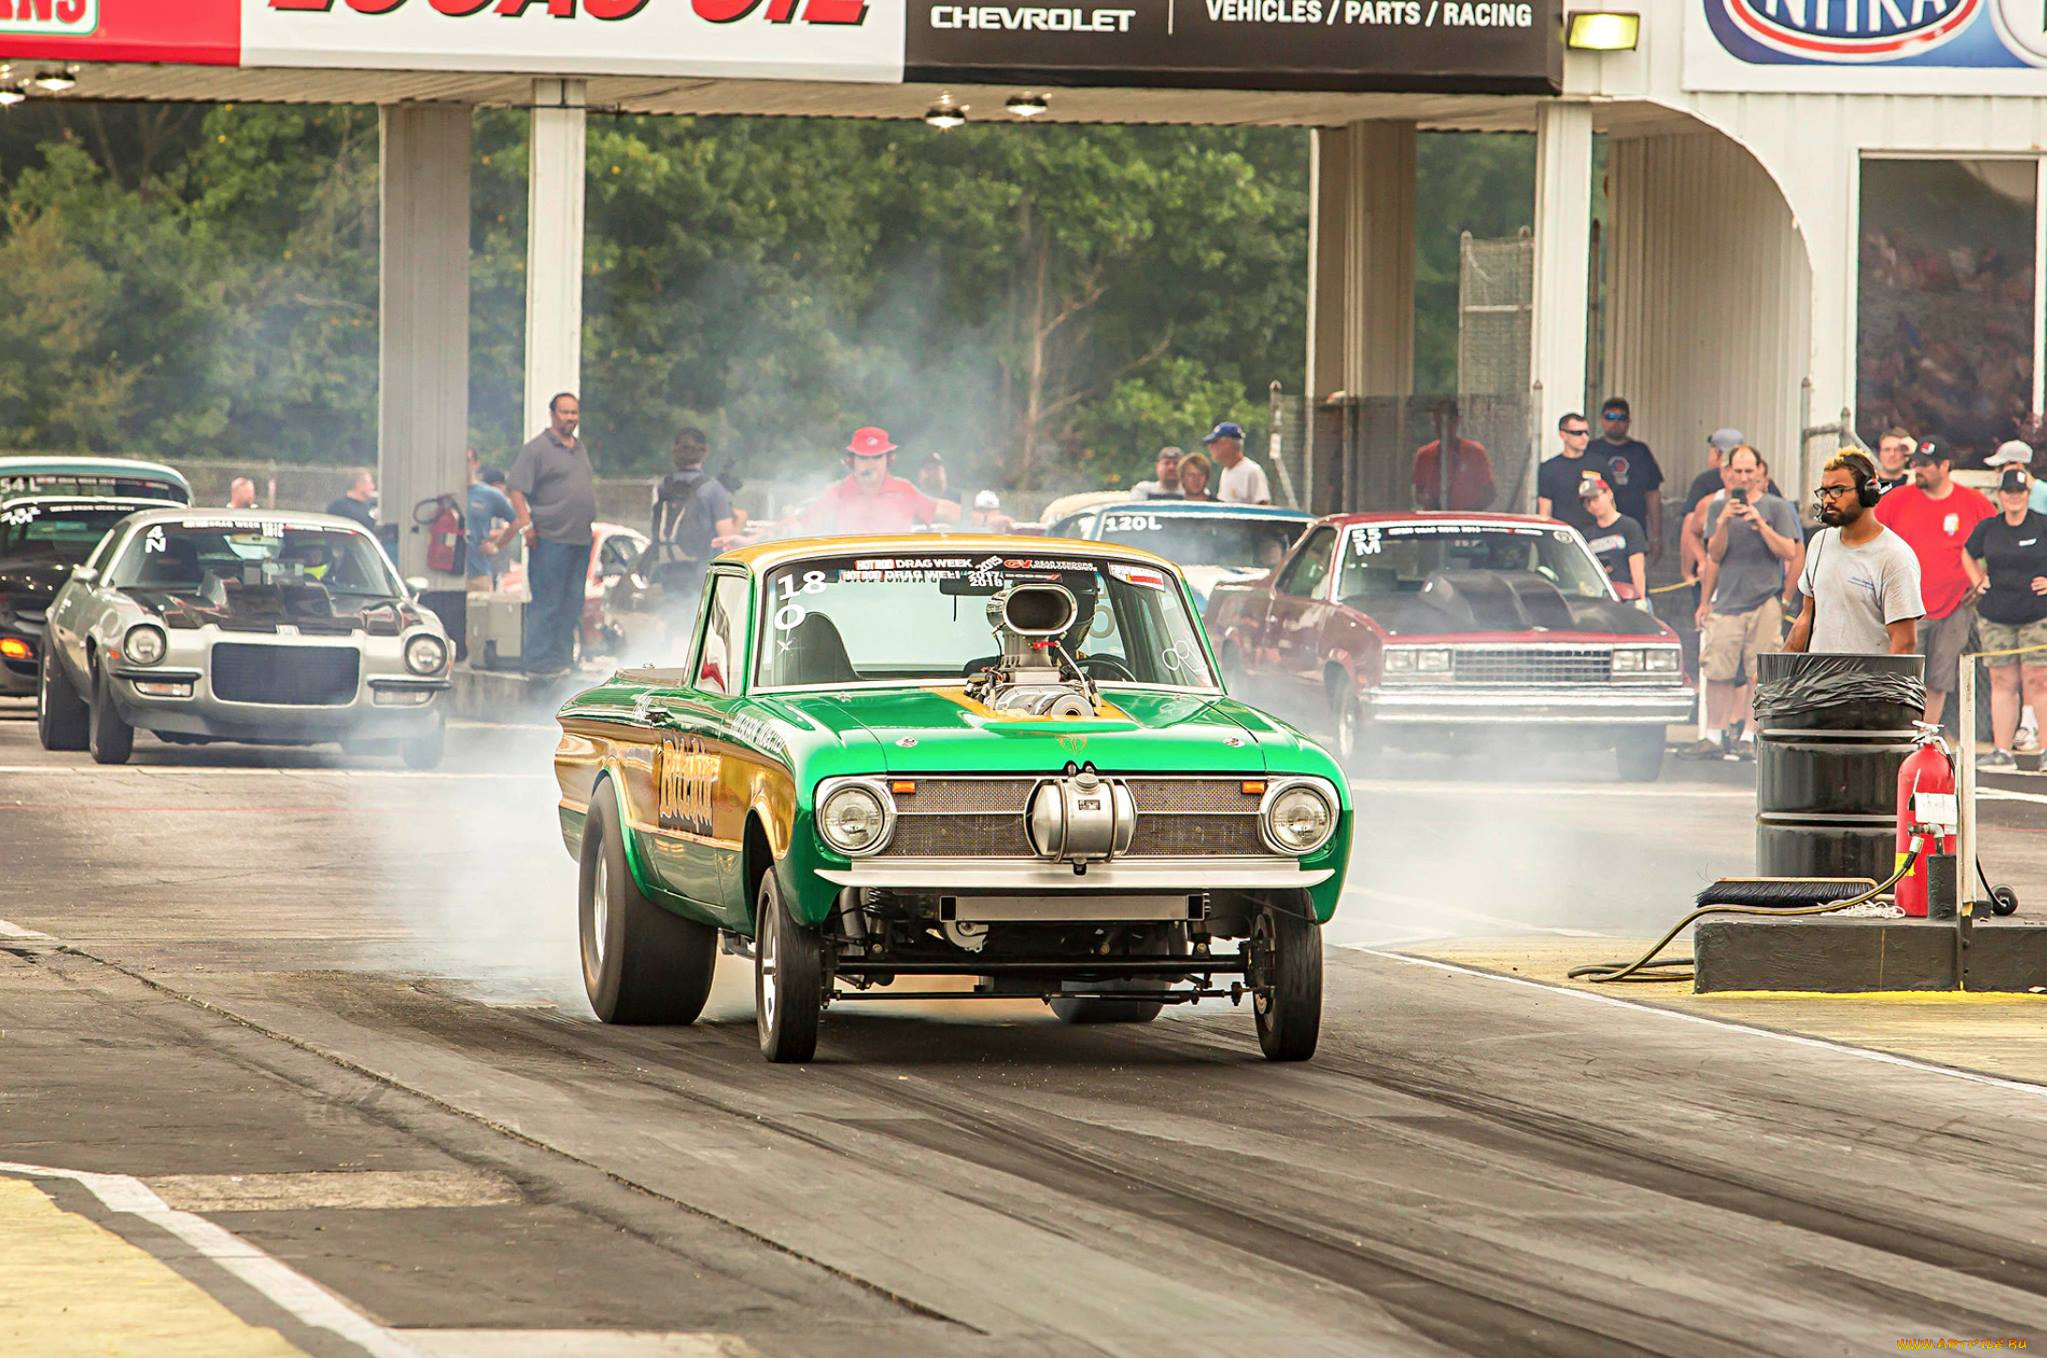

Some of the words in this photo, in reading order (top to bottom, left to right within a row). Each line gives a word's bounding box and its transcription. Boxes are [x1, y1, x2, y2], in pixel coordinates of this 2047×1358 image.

[930, 5, 1136, 32] CHEVROLET
[1205, 0, 1323, 23] VEHICLES
[1344, 1, 1422, 25] PARTS
[1443, 3, 1533, 27] RACING
[1105, 516, 1163, 532] 120L
[895, 559, 933, 568] DRAG
[933, 559, 973, 568] WEEK
[777, 570, 827, 601] 18
[884, 570, 923, 580] DRAG
